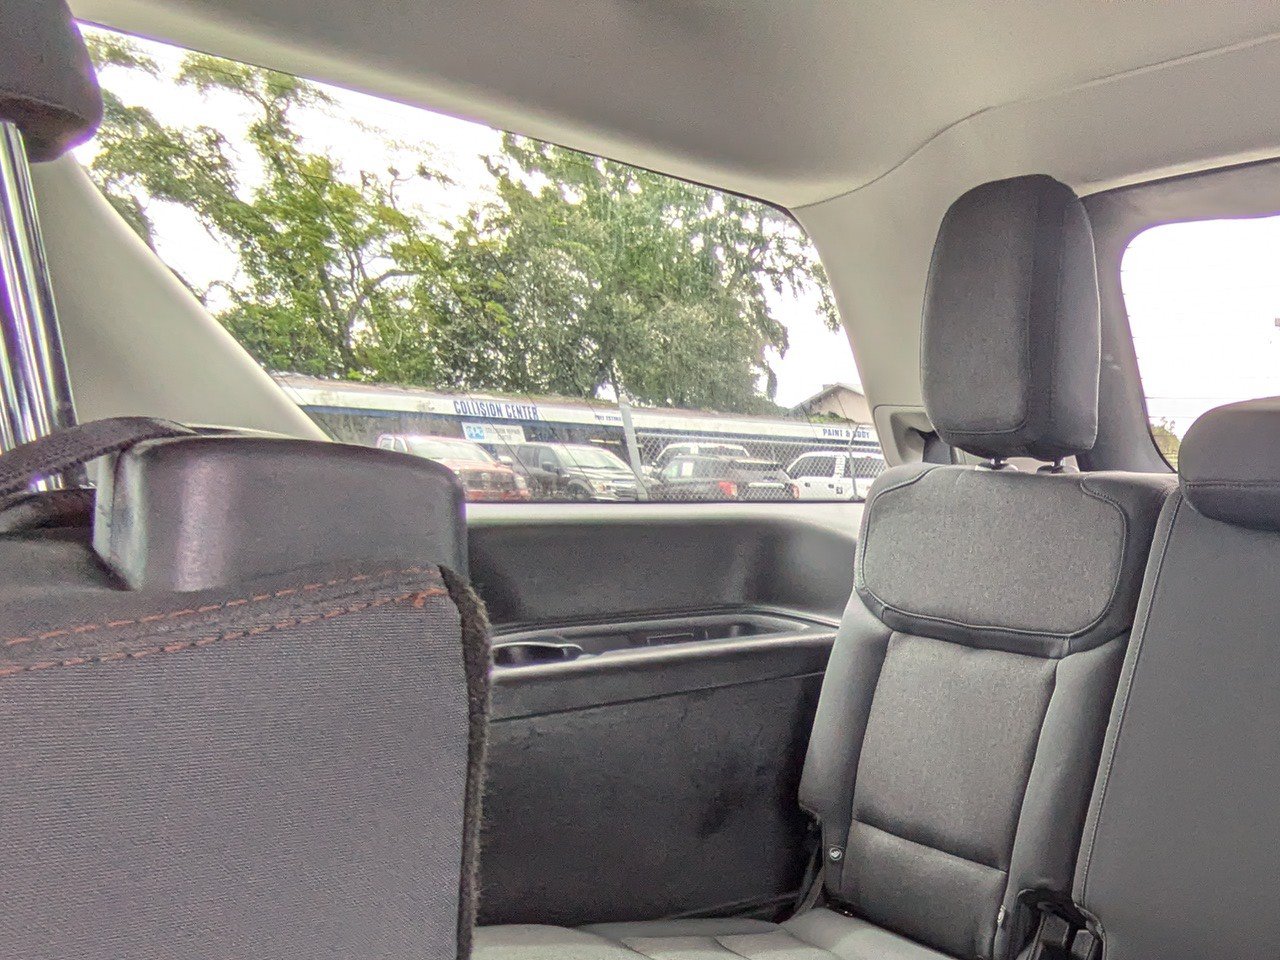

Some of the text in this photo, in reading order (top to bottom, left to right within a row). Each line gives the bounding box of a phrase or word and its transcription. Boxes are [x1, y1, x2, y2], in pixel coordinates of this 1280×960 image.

[453, 400, 540, 420] COLLISION CENTER
[822, 428, 842, 437] PAINT
